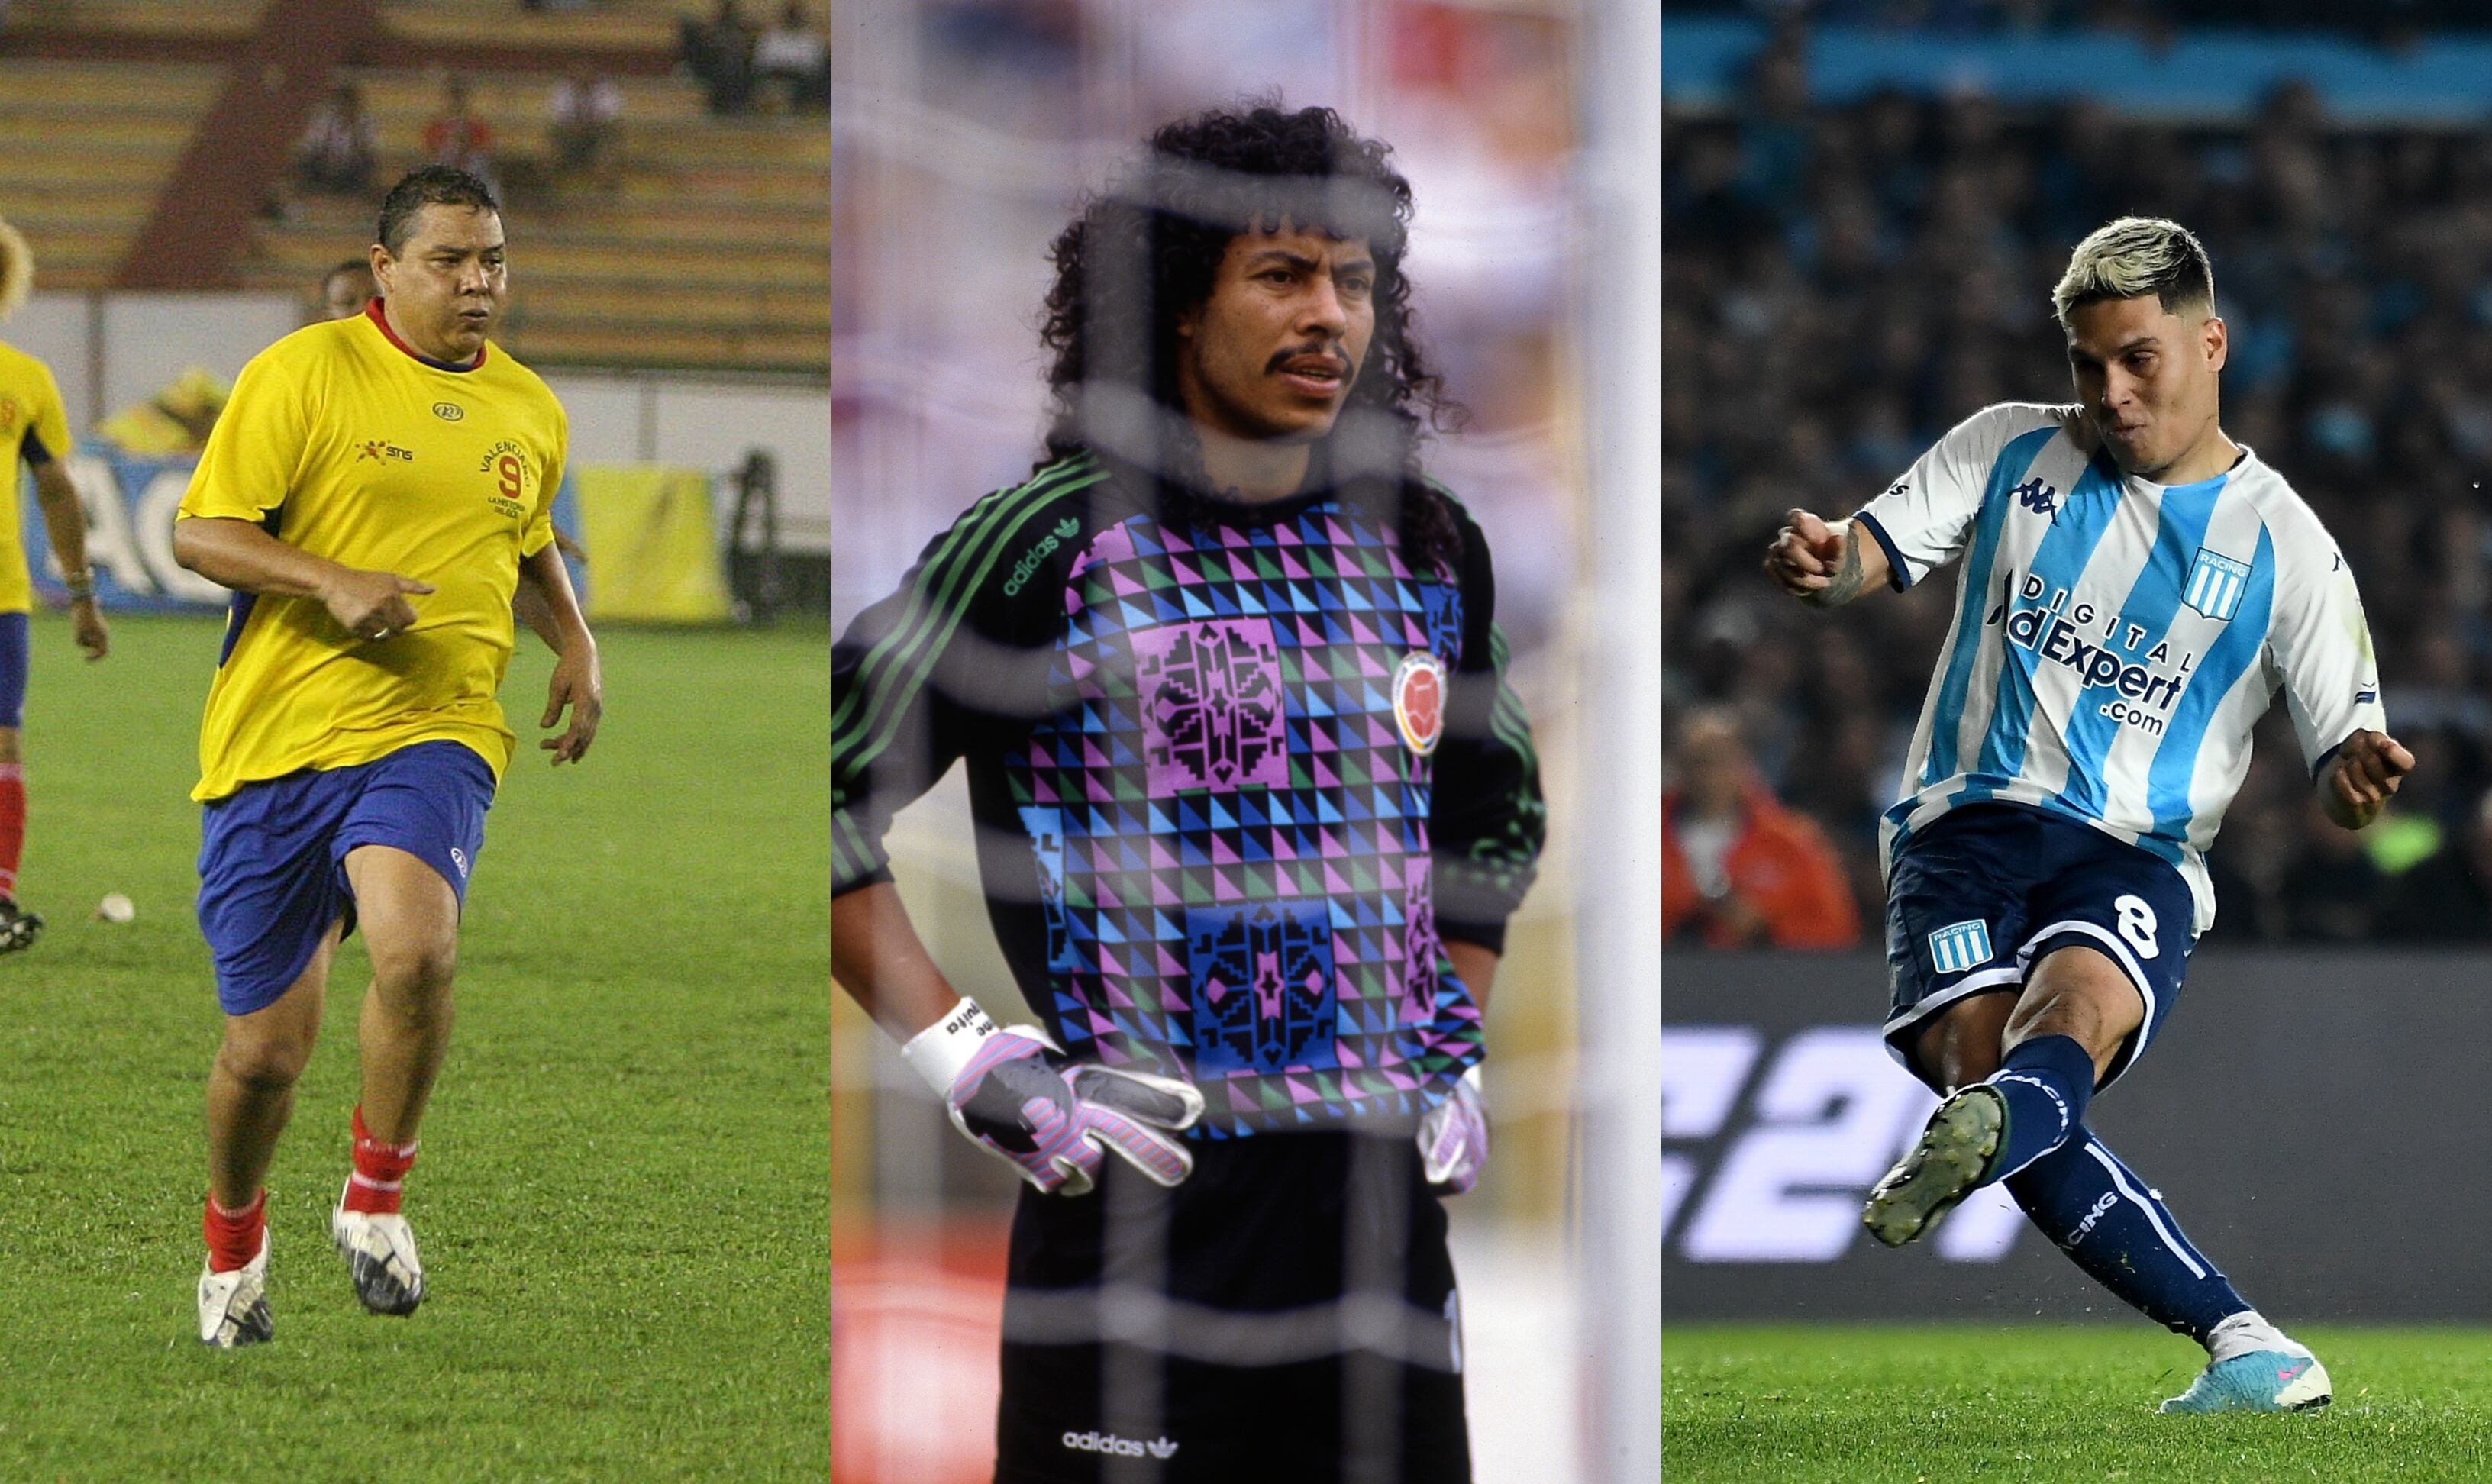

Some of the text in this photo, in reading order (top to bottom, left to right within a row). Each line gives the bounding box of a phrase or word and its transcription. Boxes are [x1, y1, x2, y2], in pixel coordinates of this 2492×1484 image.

[499, 455, 521, 499] 9
[1003, 535, 1060, 597] adidas
[2200, 553, 2247, 578] RACING
[2022, 575, 2193, 673] DIGITAL
[2100, 702, 2164, 737] .com
[1934, 922, 1981, 942] RACING
[2114, 894, 2160, 960] 8
[1062, 1431, 1145, 1458] adidas
